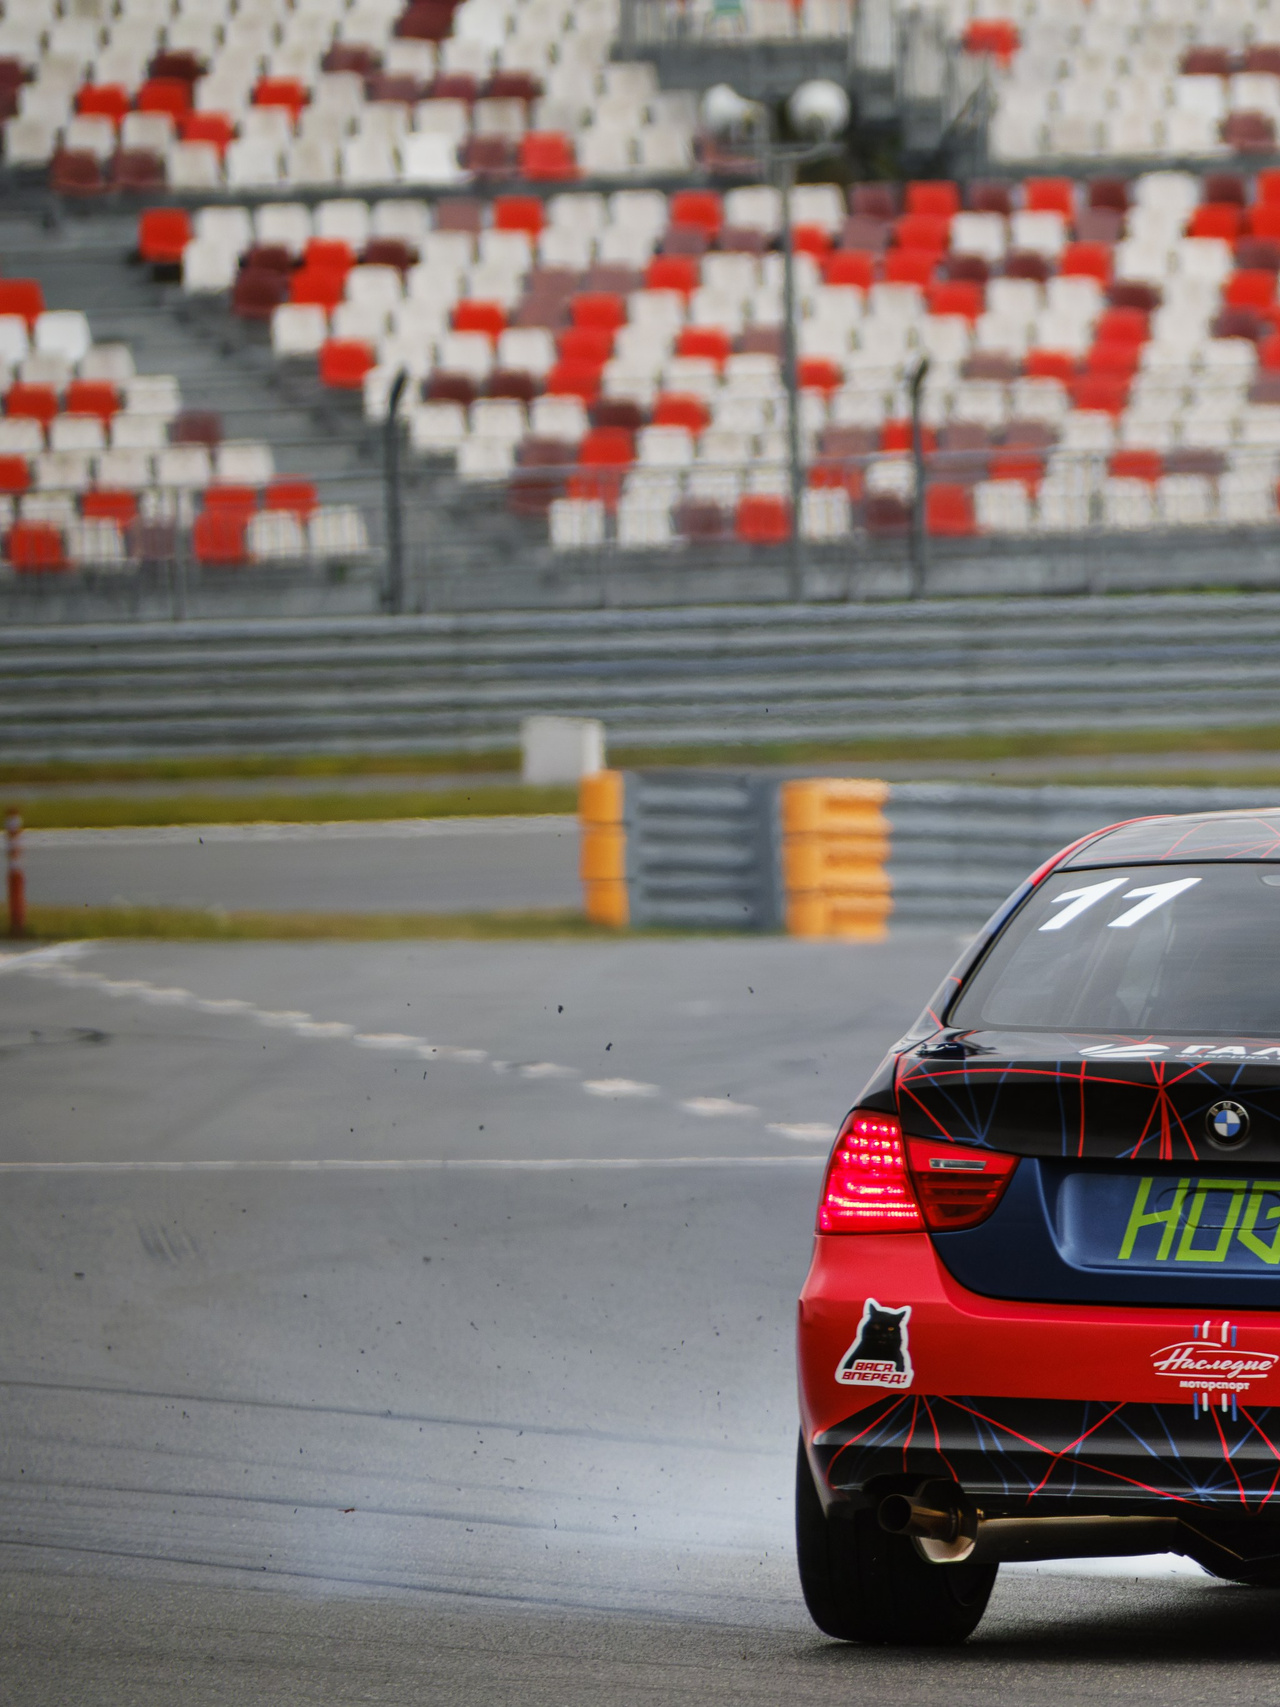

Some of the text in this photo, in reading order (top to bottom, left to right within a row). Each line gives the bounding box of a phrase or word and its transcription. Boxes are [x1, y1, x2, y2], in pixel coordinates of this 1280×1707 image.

[1038, 877, 1203, 931] 11
[841, 1371, 908, 1384] ВПЕРЕД!
[1153, 1347, 1273, 1378] Наследие
